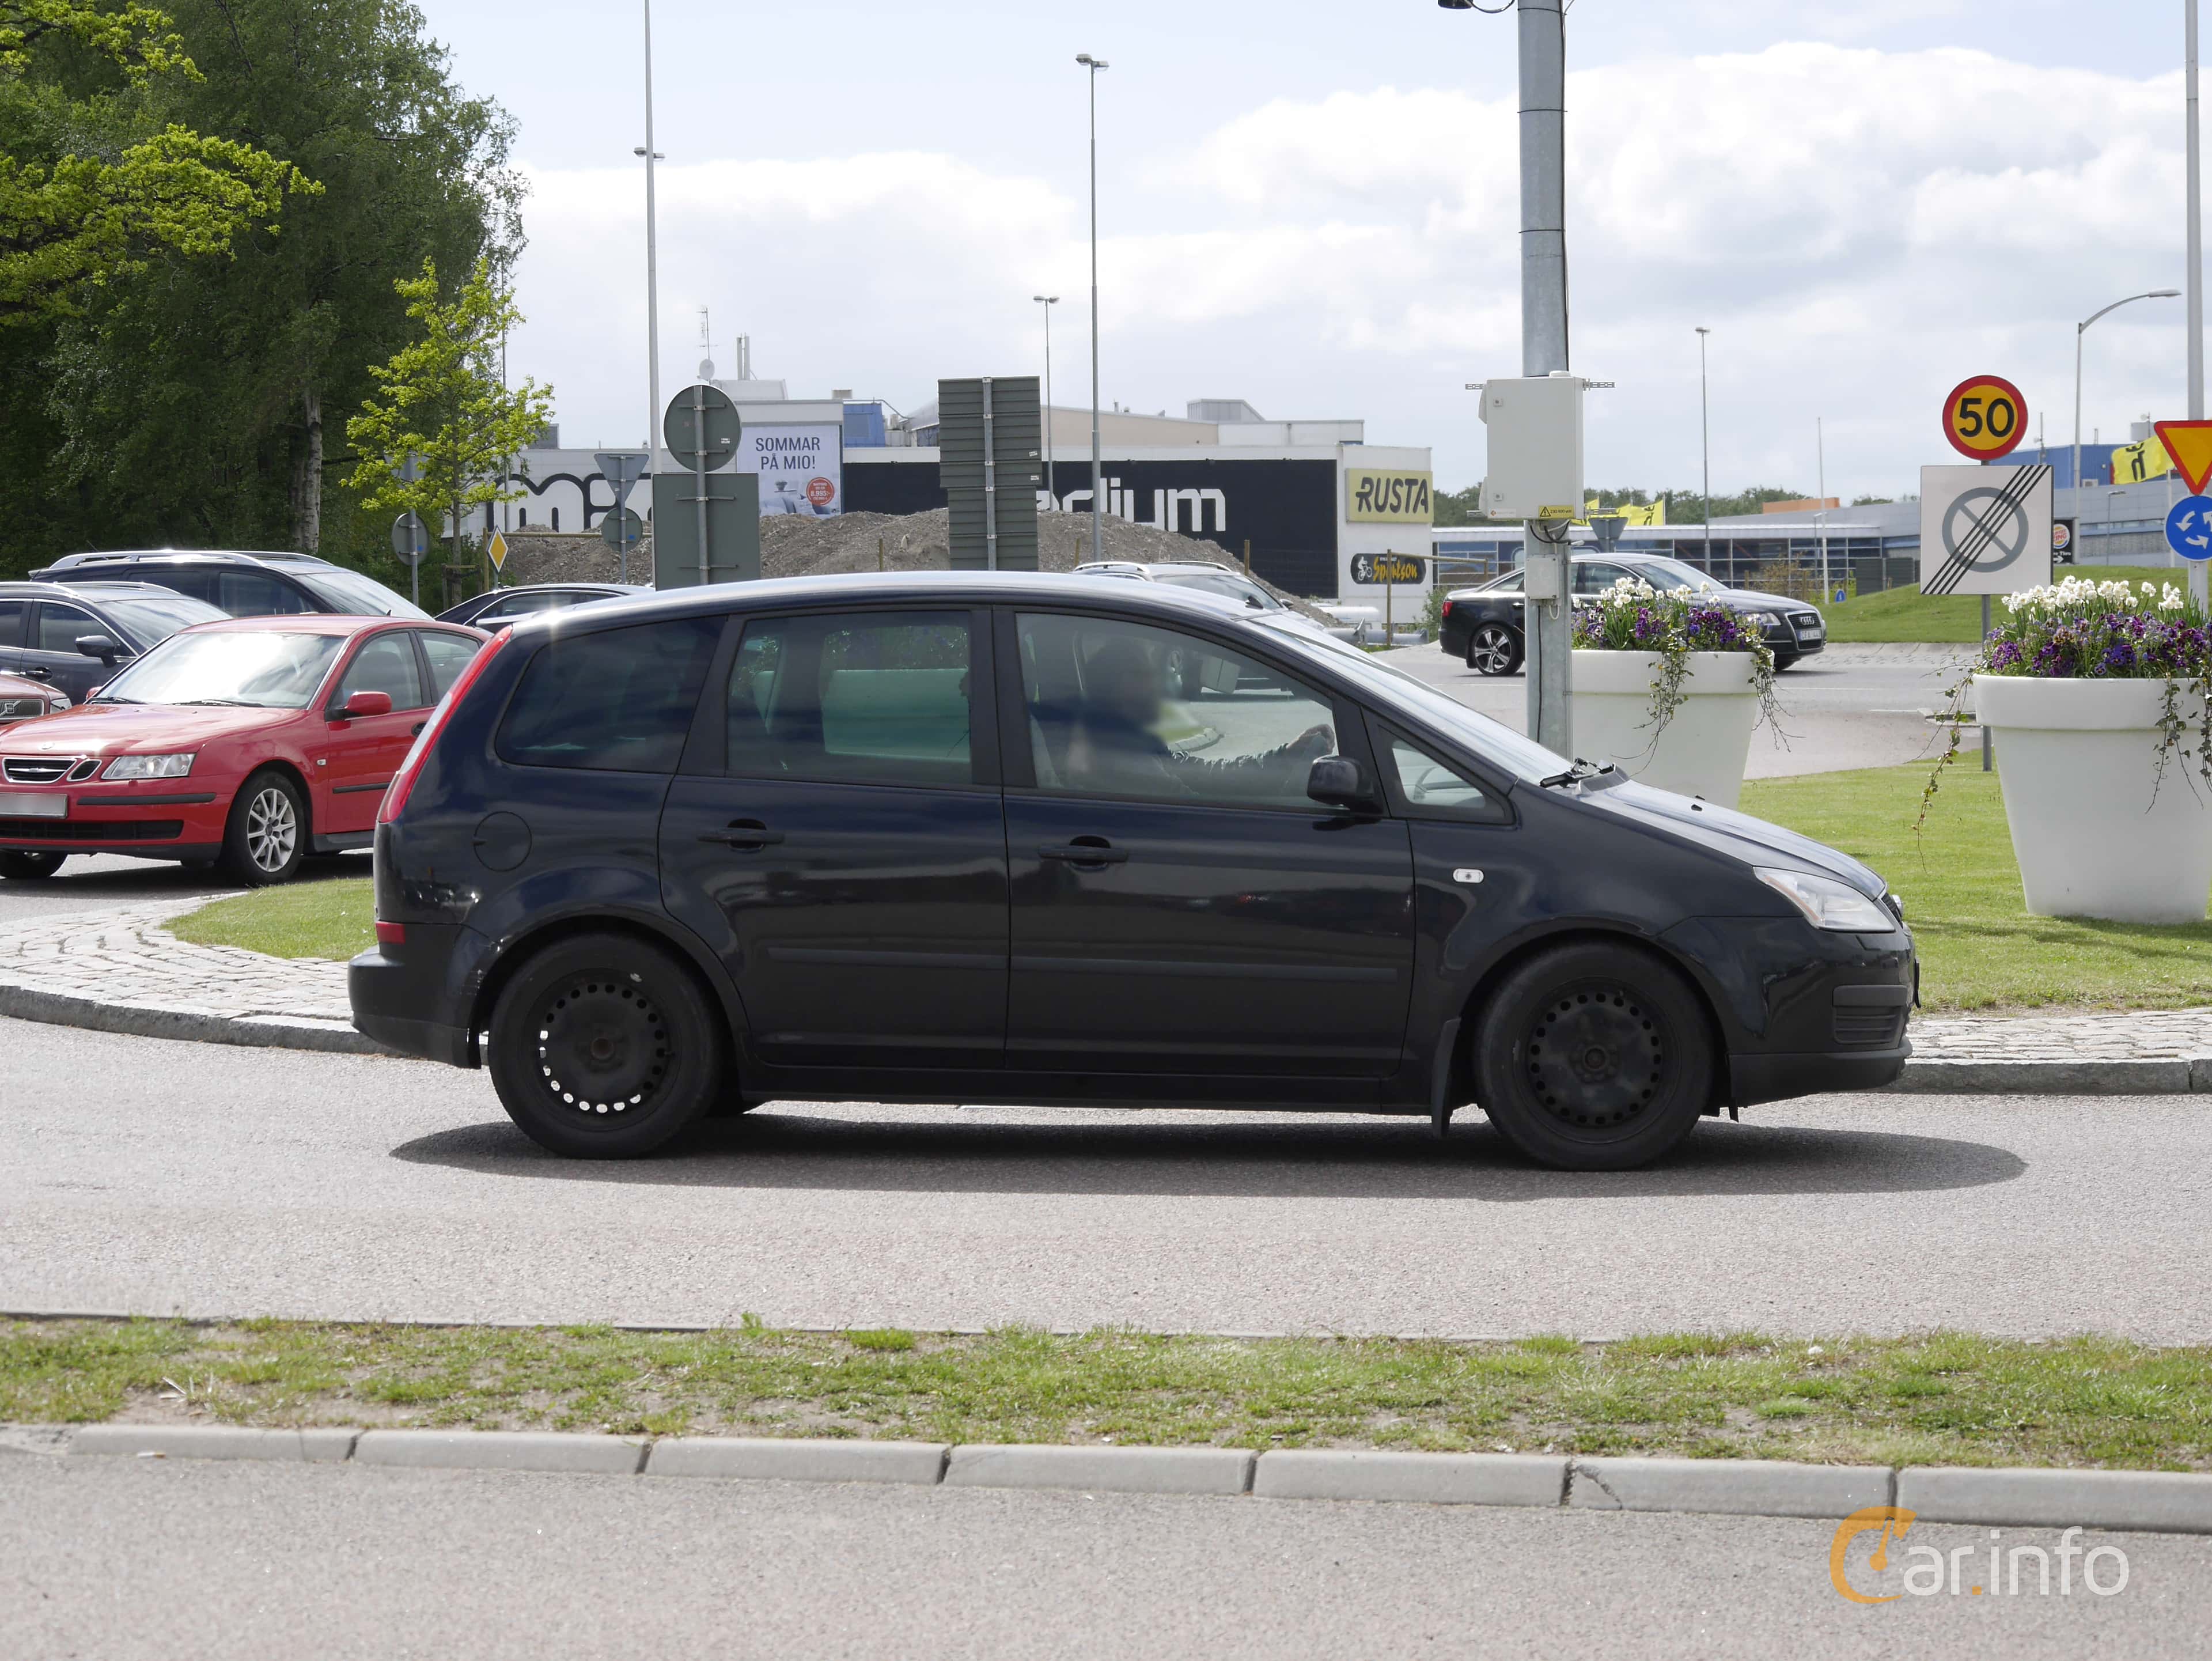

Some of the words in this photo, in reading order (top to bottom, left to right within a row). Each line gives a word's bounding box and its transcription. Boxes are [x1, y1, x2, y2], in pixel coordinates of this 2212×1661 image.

[1959, 398, 2014, 437] 50
[756, 437, 820, 451] SOMMAR
[761, 453, 779, 470] PÅ
[783, 455, 815, 470] MIO!
[1355, 476, 1429, 514] RUSTA
[1373, 556, 1418, 582] Sprtson
